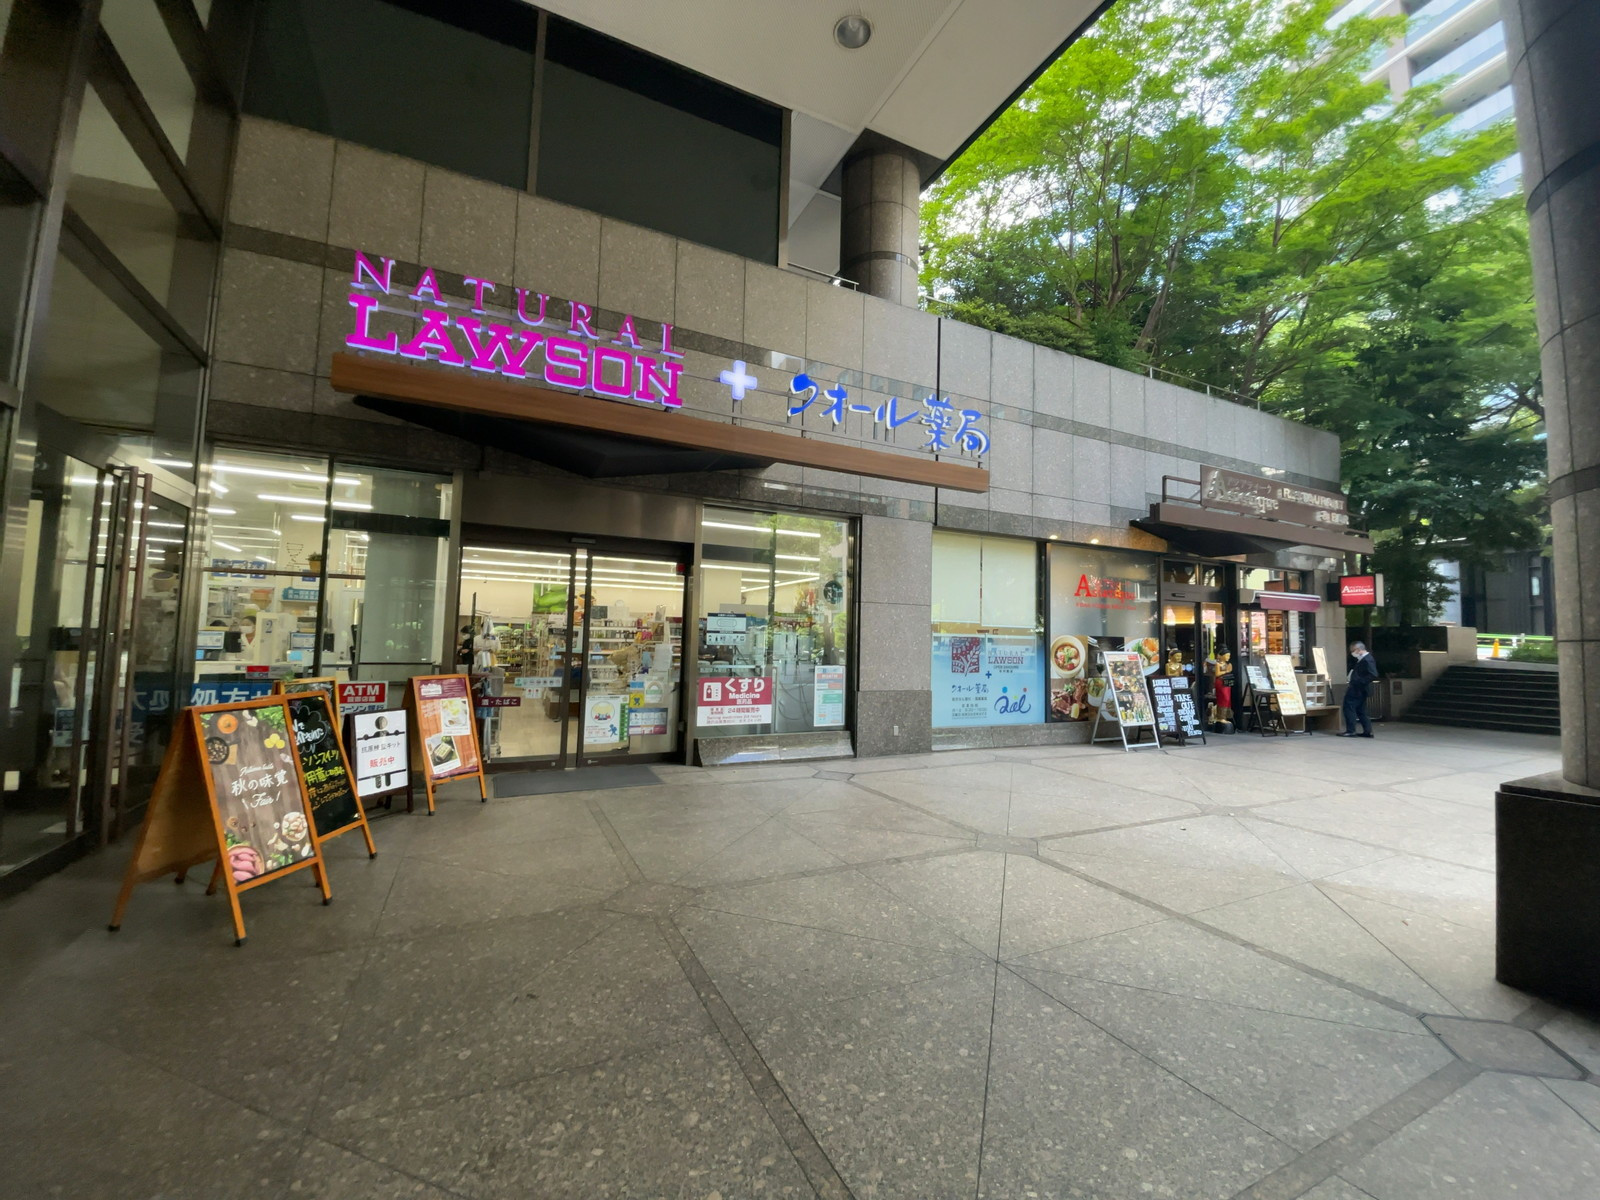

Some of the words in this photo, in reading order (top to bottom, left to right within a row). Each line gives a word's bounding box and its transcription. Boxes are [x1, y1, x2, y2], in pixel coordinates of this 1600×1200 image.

[351, 250, 686, 358] NATURAL
[346, 293, 683, 408] LAWSON
[788, 372, 991, 455] クオール薬局
[265, 619, 273, 634] 2
[988, 656, 1024, 665] LAWSON
[343, 684, 380, 697] ATM
[725, 677, 765, 692] くすり
[369, 756, 395, 768] 販売中
[231, 769, 289, 797] 秋の味覚
